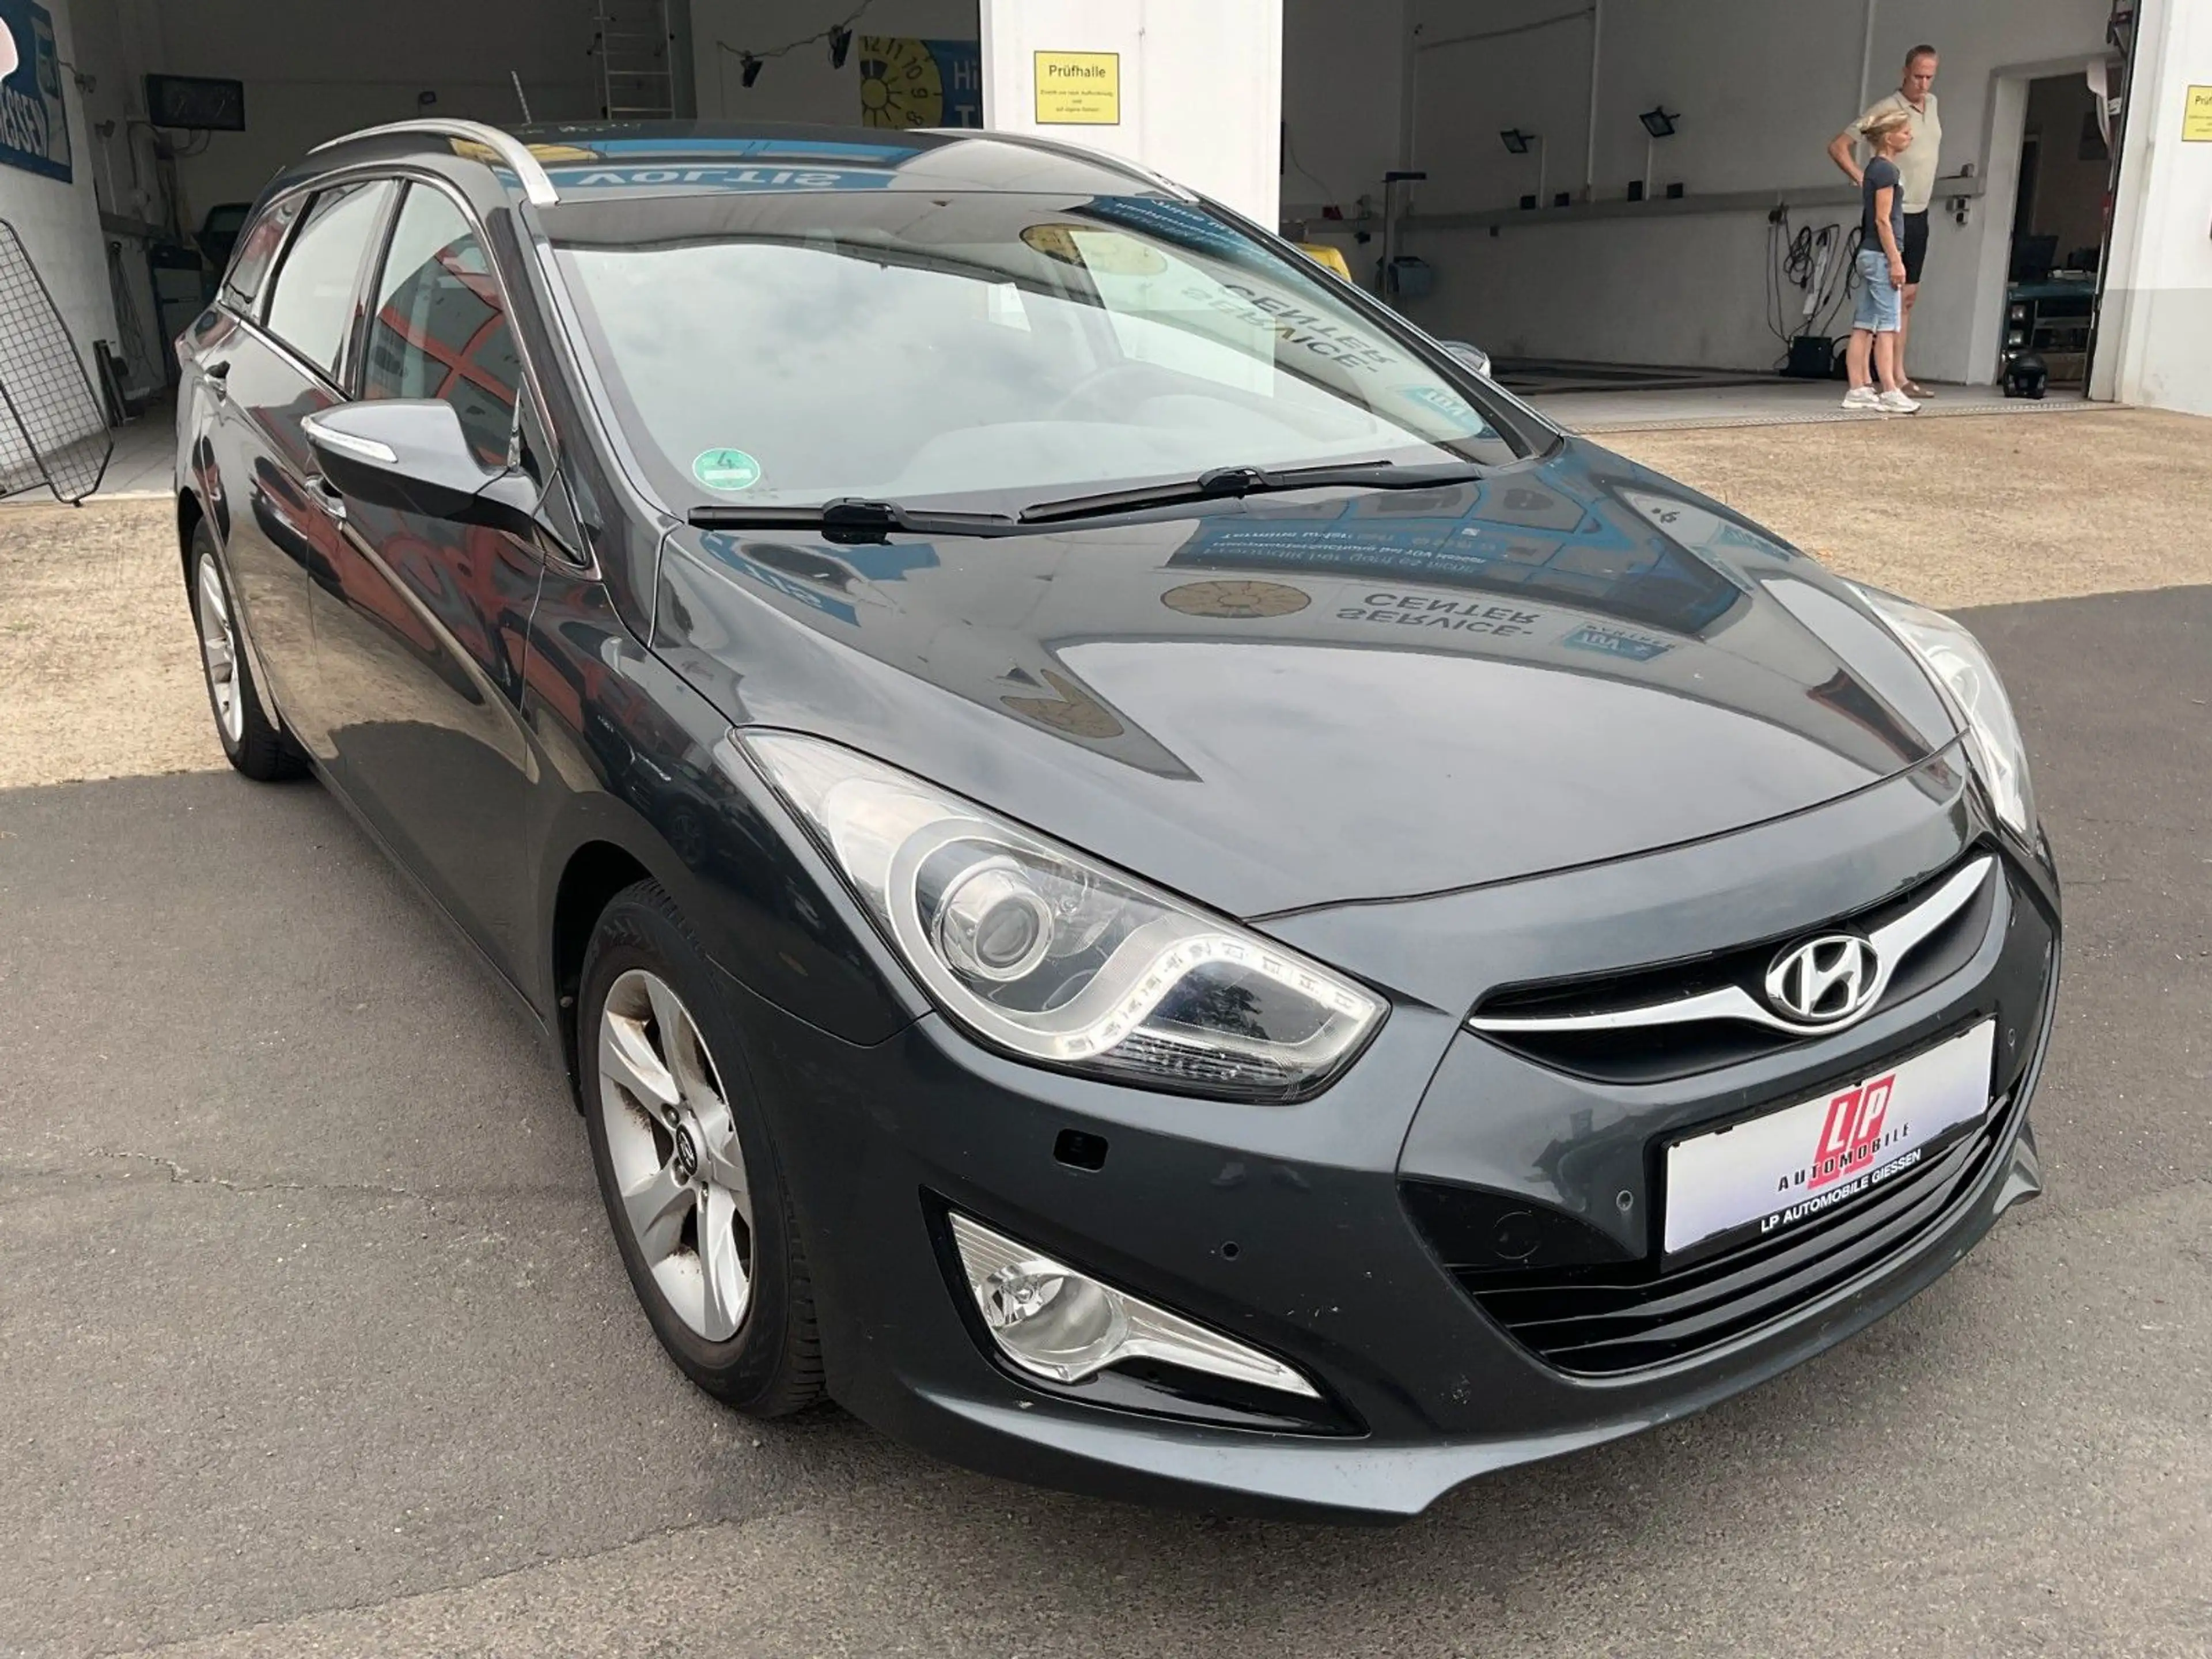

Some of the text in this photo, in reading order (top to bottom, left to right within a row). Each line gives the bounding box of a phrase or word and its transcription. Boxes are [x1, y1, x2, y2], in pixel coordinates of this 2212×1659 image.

[901, 56, 922, 79] 10
[1048, 64, 1106, 78] Prüfhalle
[911, 88, 928, 99] 9
[1810, 1075, 1896, 1182] LP
[1778, 1123, 1911, 1192] AUTOMOBILE
[1760, 1149, 1922, 1232] LP AUTOMOBILE GIESSEN
